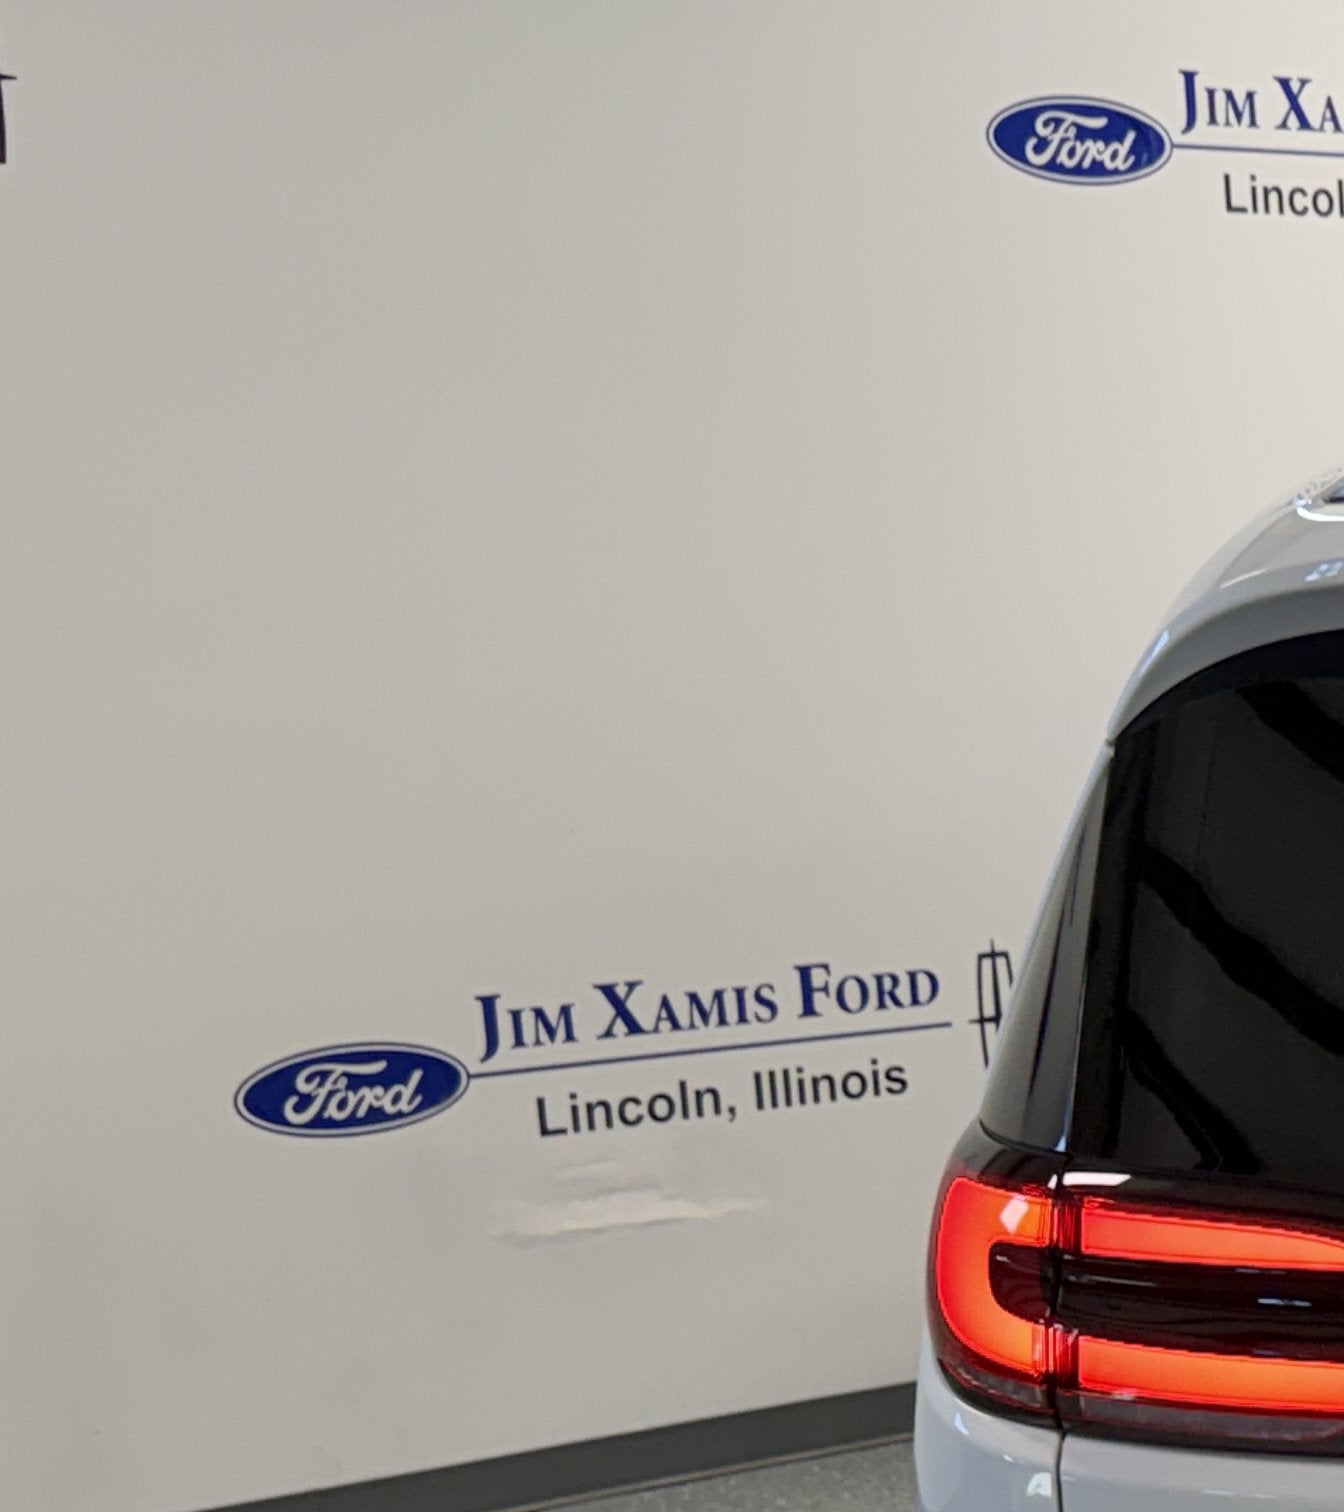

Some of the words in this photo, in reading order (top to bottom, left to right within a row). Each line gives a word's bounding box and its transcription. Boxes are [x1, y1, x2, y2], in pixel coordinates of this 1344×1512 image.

[1178, 69, 1258, 134] JIM
[1024, 109, 1136, 175] Ford
[474, 993, 579, 1062] JIM
[594, 979, 779, 1039] XAMIS
[794, 962, 941, 1020] FORD
[283, 1060, 423, 1125] Ford
[536, 1079, 738, 1137] Lincoln,
[752, 1056, 909, 1110] Illinois
